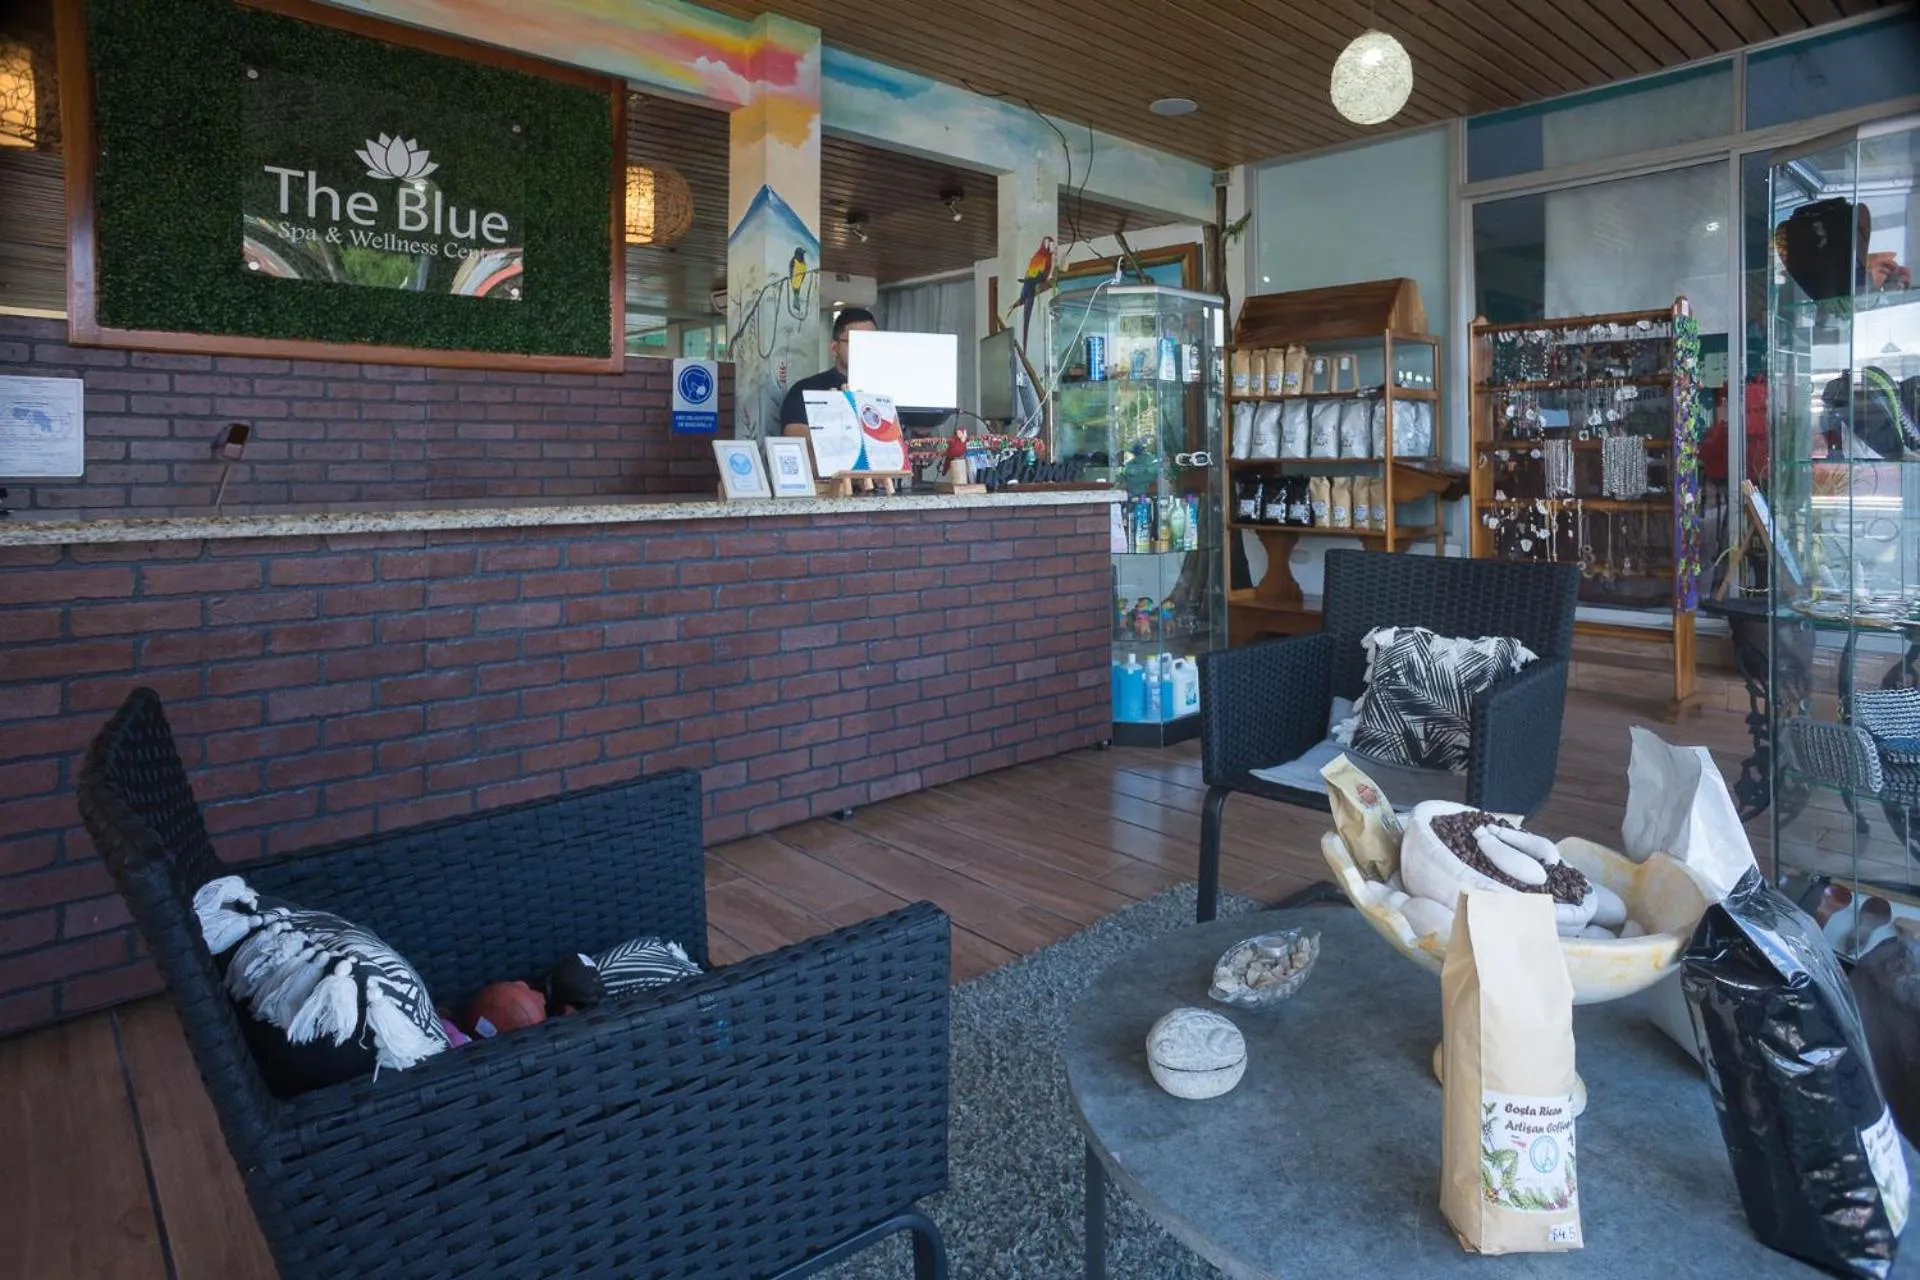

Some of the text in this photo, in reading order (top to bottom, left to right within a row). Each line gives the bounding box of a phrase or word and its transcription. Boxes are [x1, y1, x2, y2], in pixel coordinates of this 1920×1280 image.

[264, 165, 509, 244] The Blue
[277, 221, 317, 246] Spa
[325, 226, 343, 244] &
[350, 229, 438, 256] Wellness
[1504, 1102, 1537, 1117] Costa
[1504, 1119, 1545, 1134] Artisan
